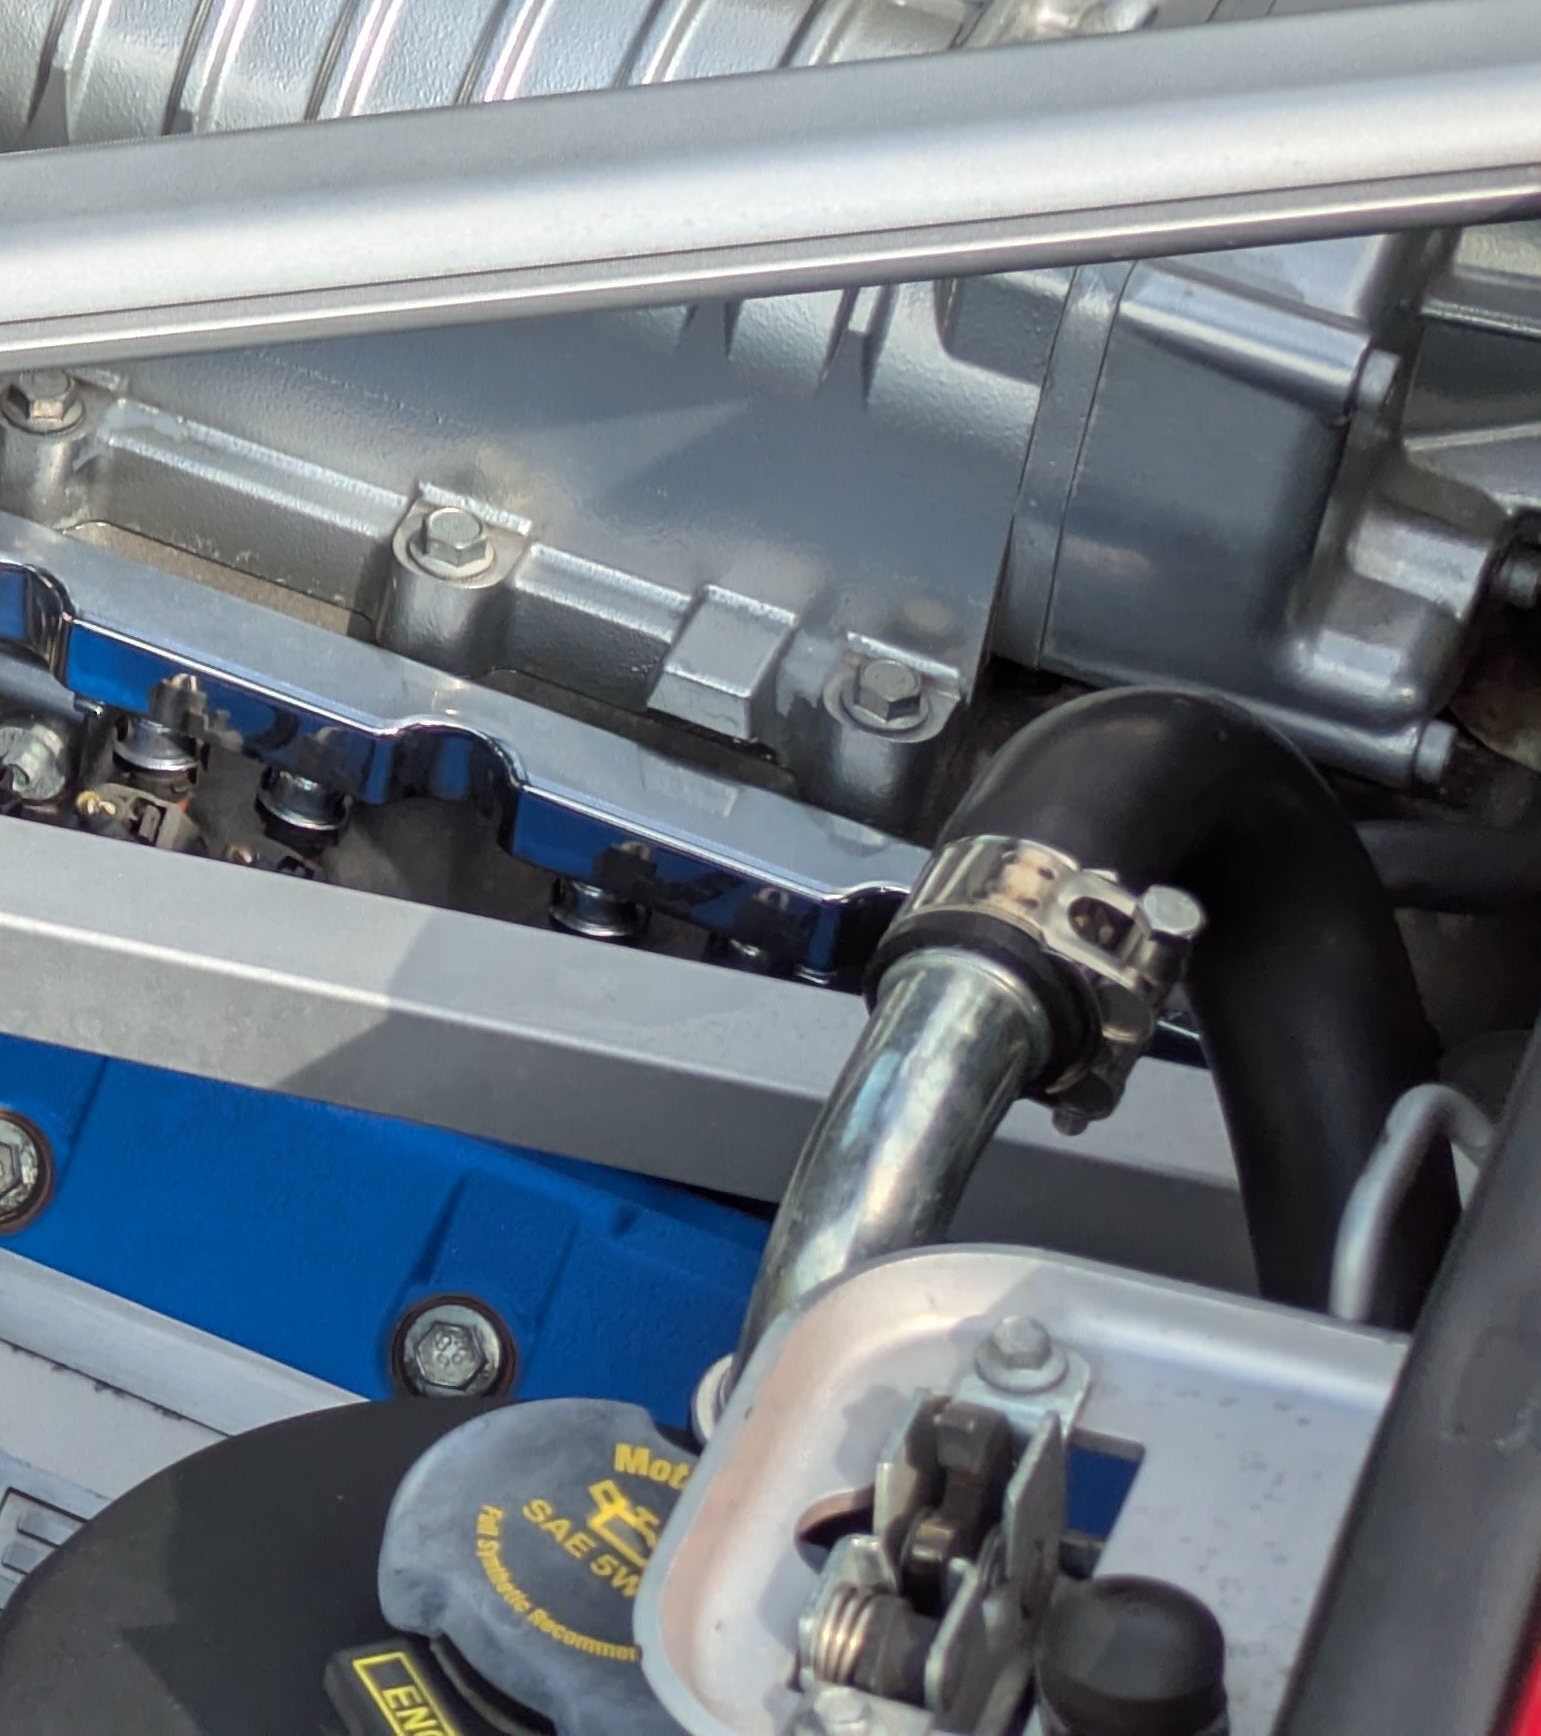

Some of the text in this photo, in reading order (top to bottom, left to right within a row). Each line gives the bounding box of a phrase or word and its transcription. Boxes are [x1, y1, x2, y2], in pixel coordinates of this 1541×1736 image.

[614, 1443, 690, 1491] Mot
[522, 1499, 597, 1560] SAE
[382, 1684, 445, 1736] EN
